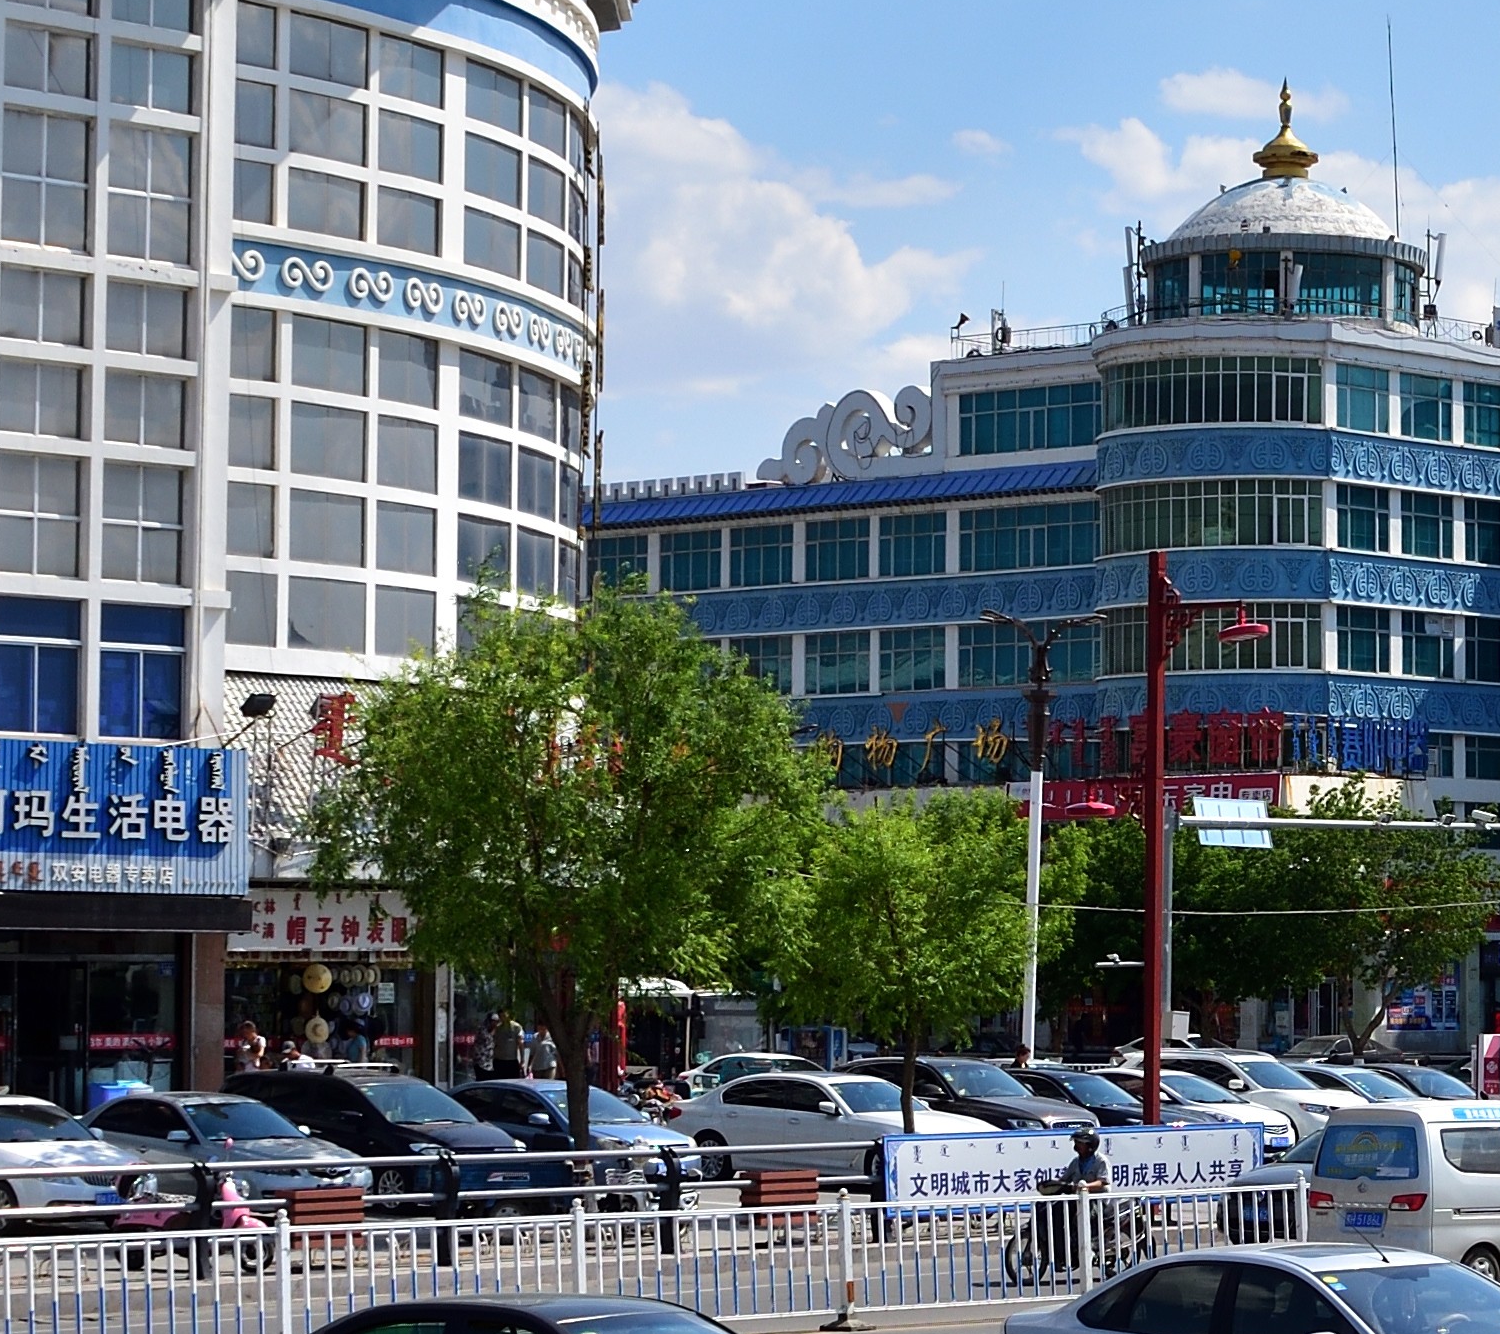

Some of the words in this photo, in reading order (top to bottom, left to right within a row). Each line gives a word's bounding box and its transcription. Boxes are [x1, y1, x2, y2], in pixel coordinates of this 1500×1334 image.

[50, 860, 175, 886] 双安电器专卖店
